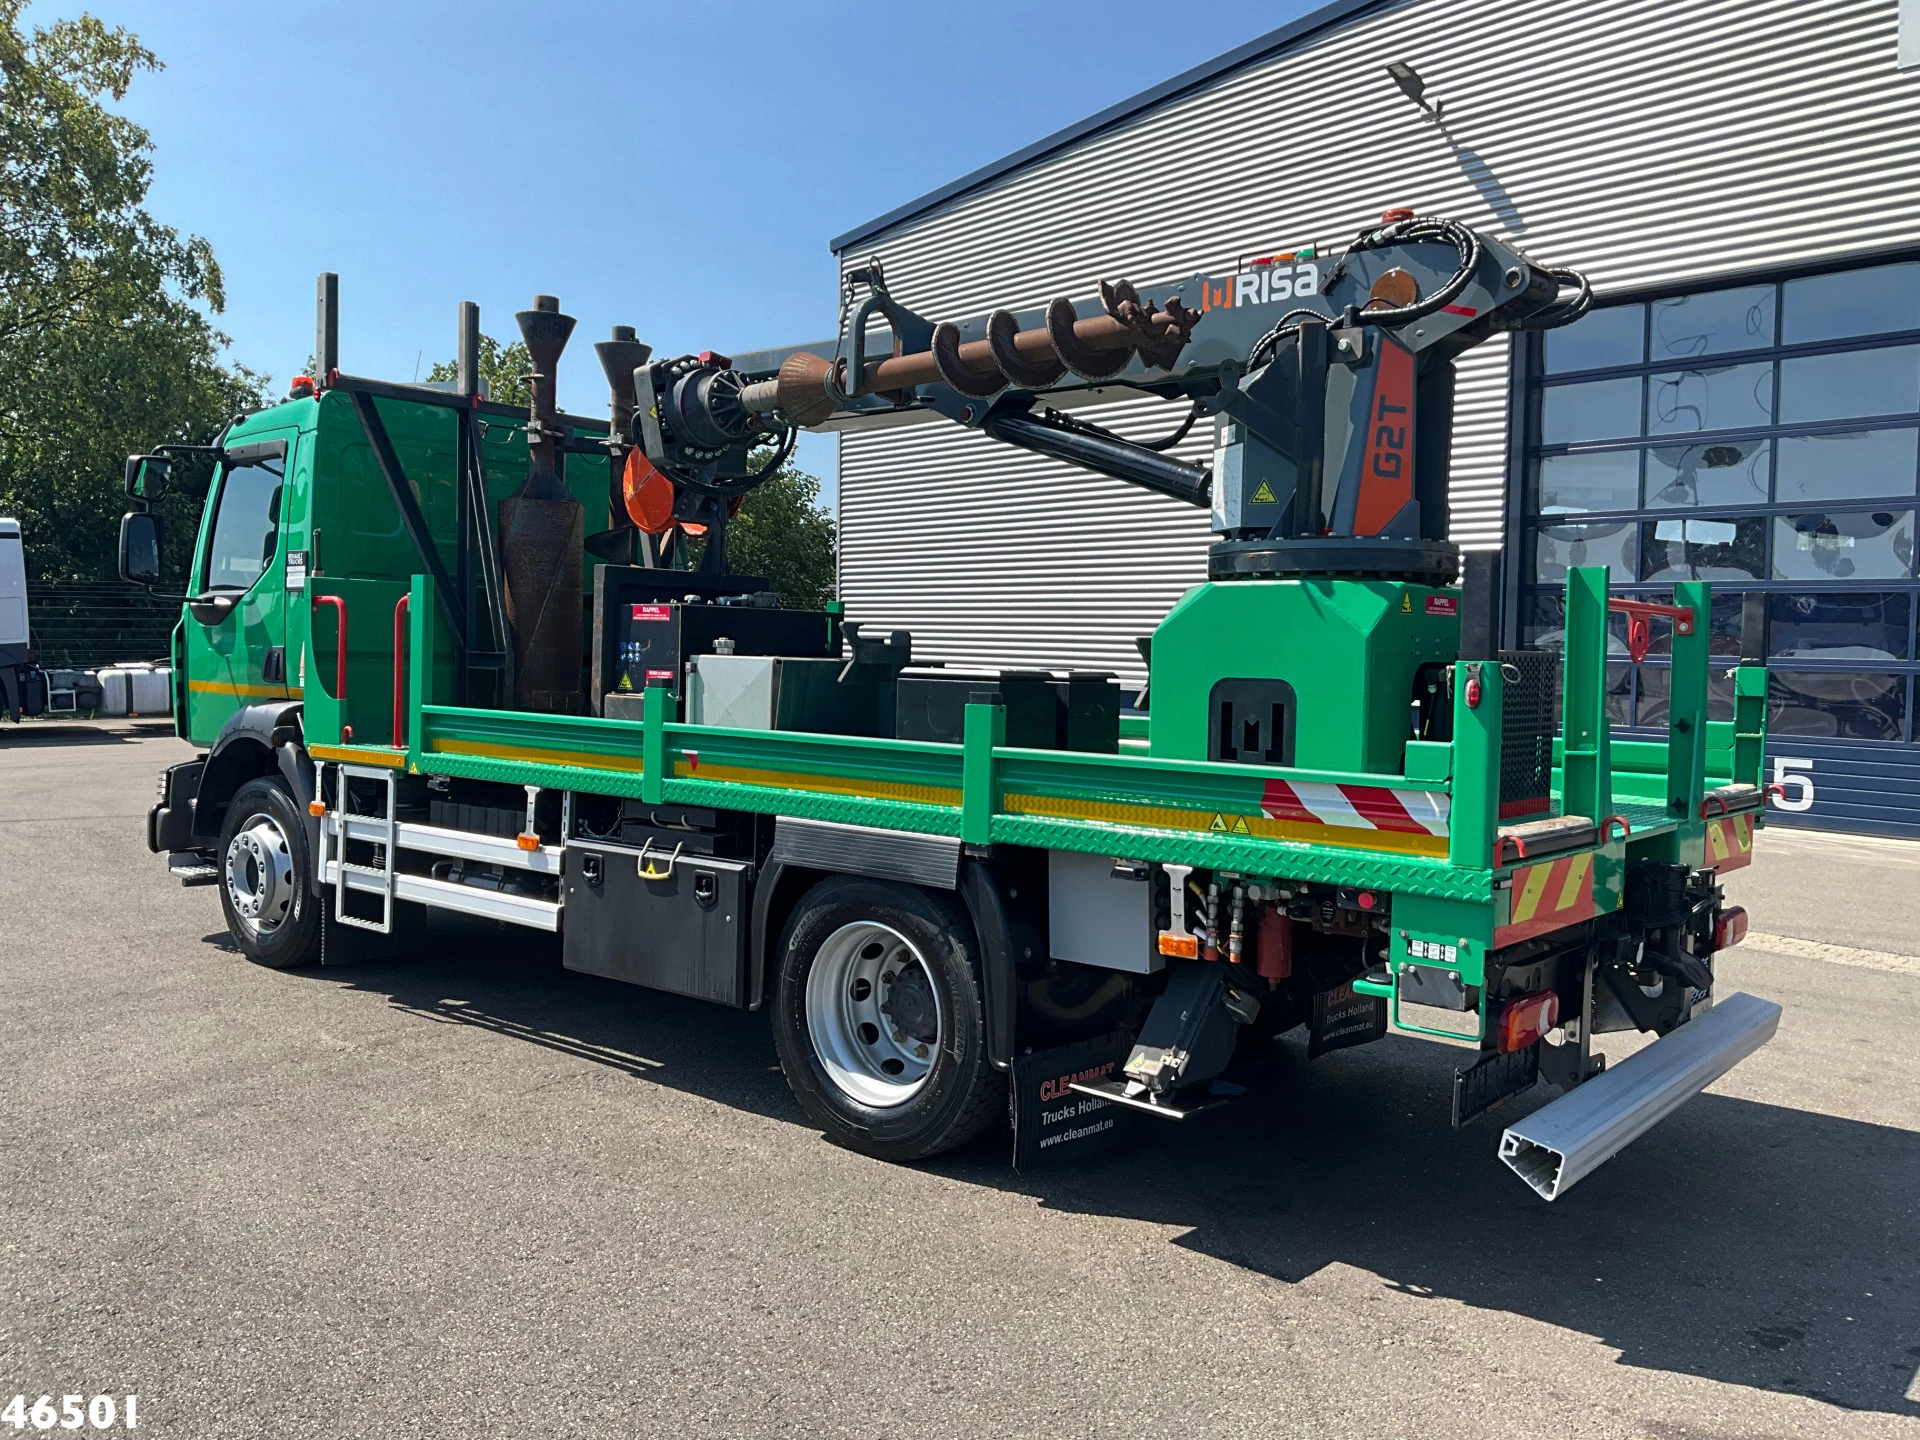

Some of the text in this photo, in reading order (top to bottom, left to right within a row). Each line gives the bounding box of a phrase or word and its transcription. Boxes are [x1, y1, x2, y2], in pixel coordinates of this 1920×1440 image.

[1372, 393, 1407, 479] G2T
[1433, 597, 1449, 607] RAPPEL
[1771, 757, 1814, 812] 5
[1326, 1000, 1374, 1025] Trucks Holland
[1322, 1021, 1374, 1042] www.cleanmat.eu
[1041, 1105, 1076, 1126] Trucks
[1039, 1118, 1114, 1149] www.cleanmat.eu
